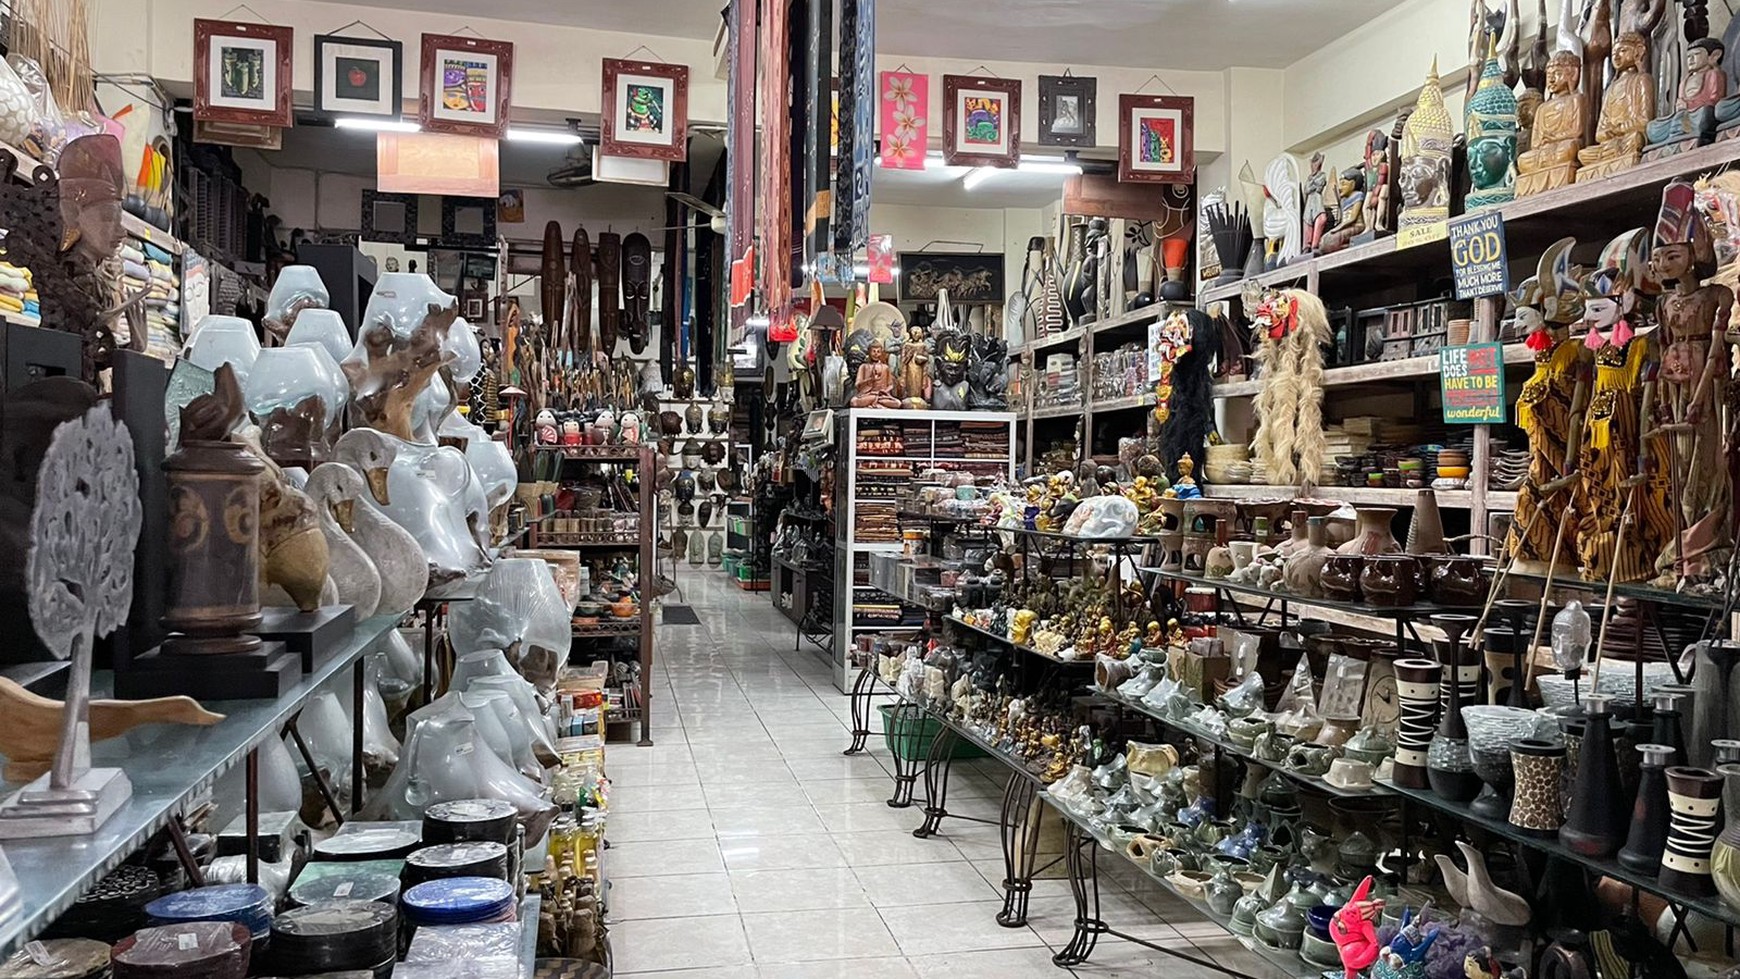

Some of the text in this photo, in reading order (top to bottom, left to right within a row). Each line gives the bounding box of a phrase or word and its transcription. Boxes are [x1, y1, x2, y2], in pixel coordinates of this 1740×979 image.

[1409, 226, 1432, 238] SALE
[1451, 214, 1498, 239] THANK YOU
[1453, 232, 1501, 266] GOD
[1491, 260, 1501, 270] ME
[1457, 271, 1503, 289] MUCH MORE
[1442, 348, 1467, 365] LIFE
[1443, 363, 1468, 378] DOES
[1445, 374, 1498, 390] HAVE TO BE
[1447, 405, 1500, 420] wonderful
